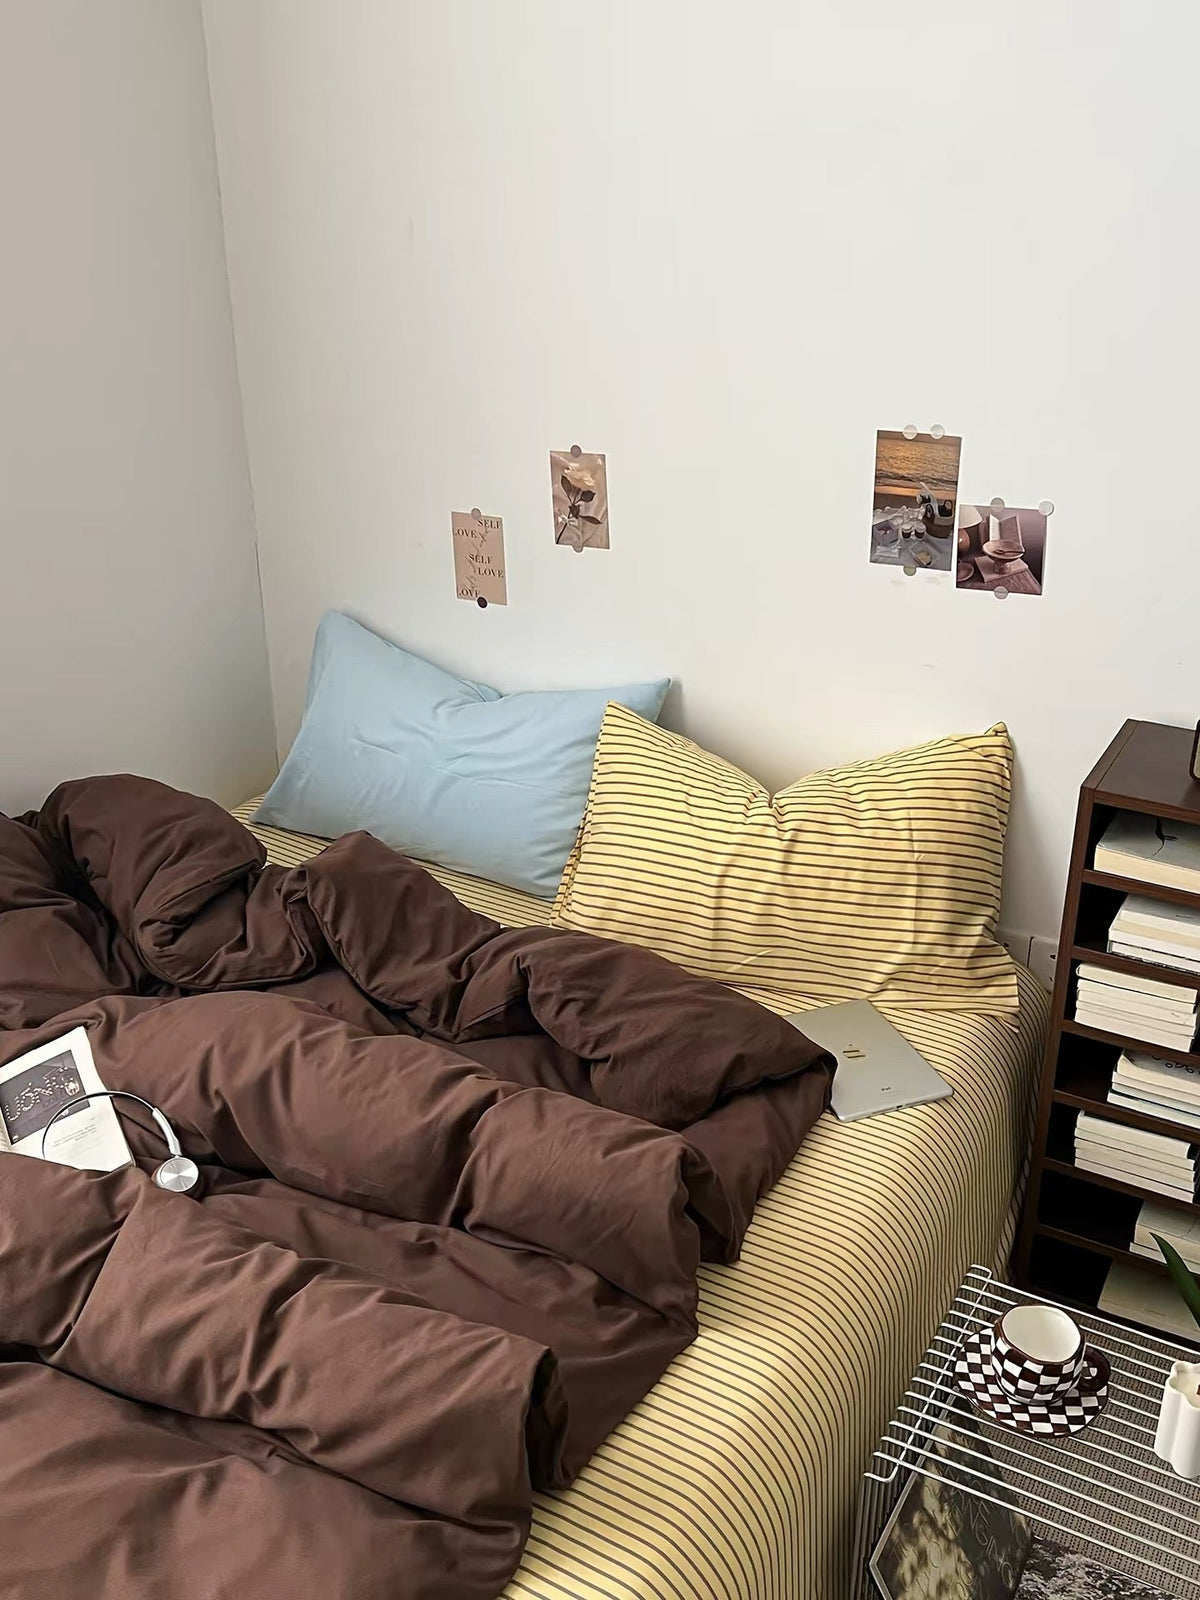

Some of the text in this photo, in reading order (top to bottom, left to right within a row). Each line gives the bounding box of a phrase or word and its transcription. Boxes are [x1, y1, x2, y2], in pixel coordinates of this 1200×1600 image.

[477, 519, 502, 530] SELF
[469, 554, 493, 565] SELF
[478, 567, 504, 579] LOVE
[458, 588, 480, 598] OVE
